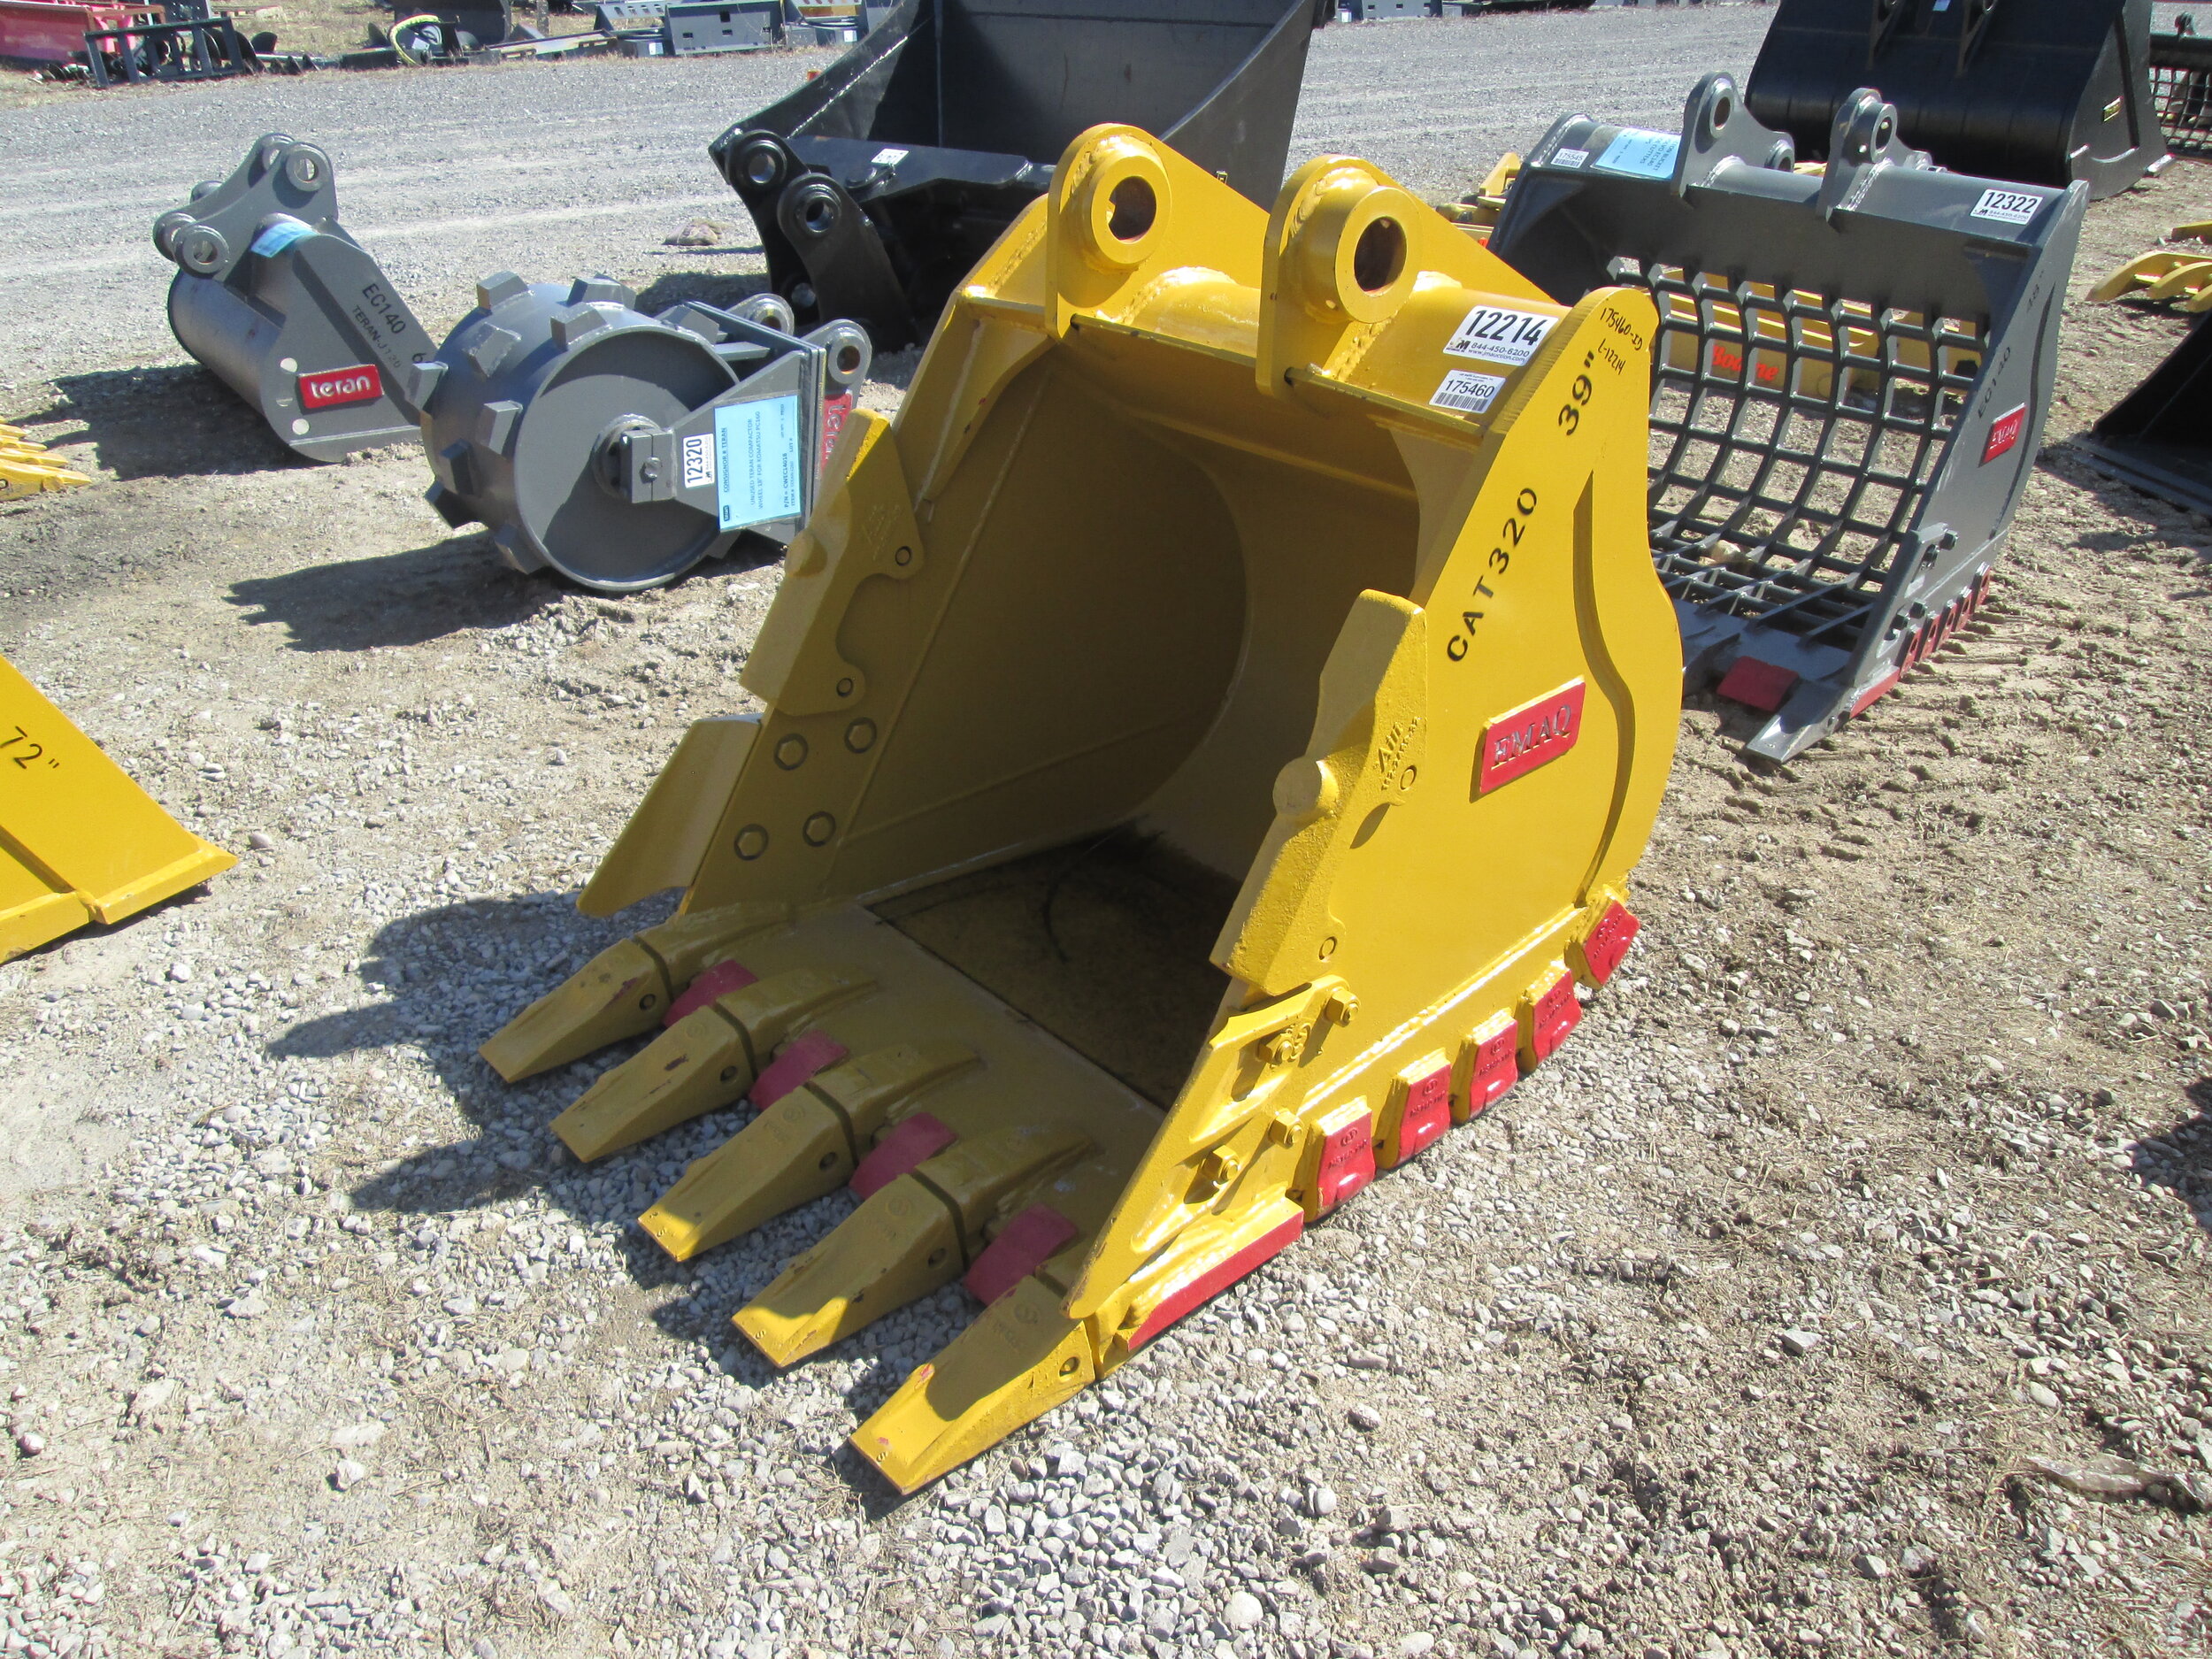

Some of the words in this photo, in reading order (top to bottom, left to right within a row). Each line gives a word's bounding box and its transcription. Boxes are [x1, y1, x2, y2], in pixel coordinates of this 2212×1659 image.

[1984, 191, 2038, 213] 12322
[363, 283, 406, 334] EC140
[1465, 309, 1548, 346] 12214
[1471, 342, 1530, 357] 844-450-6200
[311, 375, 371, 398] teran
[1445, 379, 1495, 398] 175460
[1558, 349, 1594, 436] 39"
[686, 437, 703, 484] 12320
[0, 726, 60, 770] 72"
[1492, 703, 1572, 769] EMAQ
